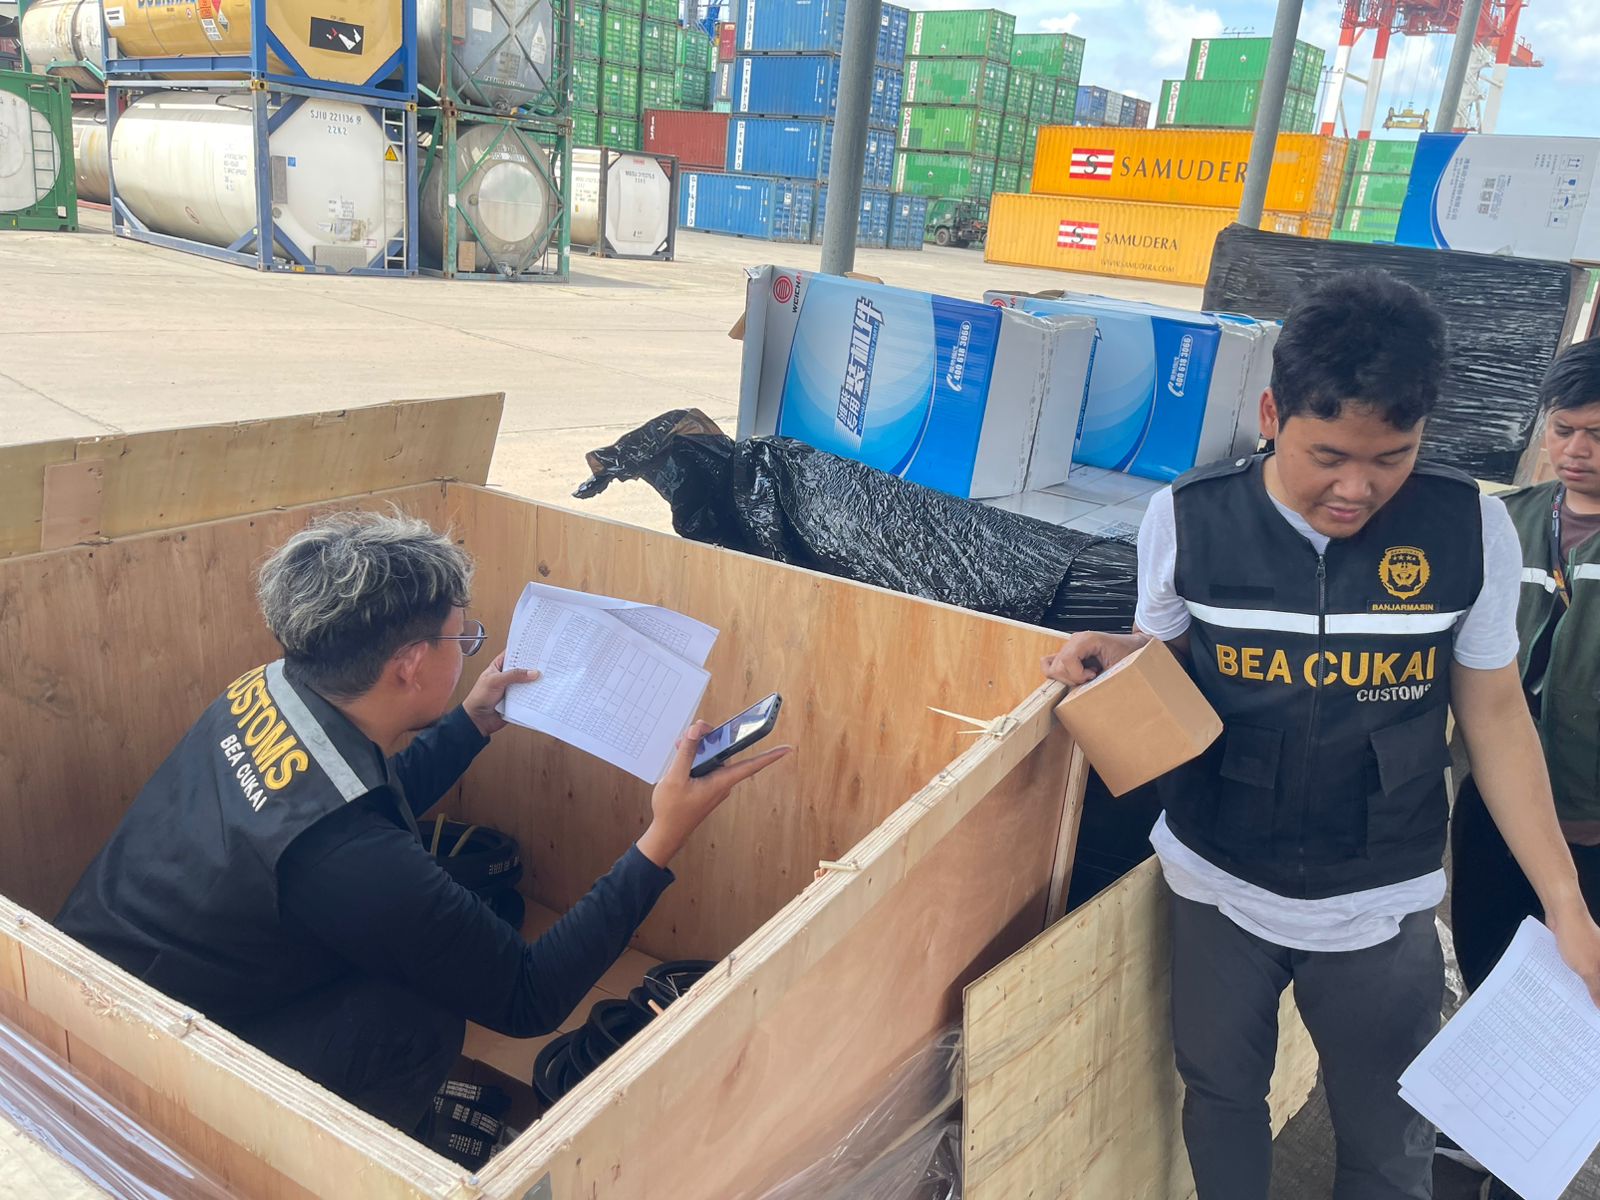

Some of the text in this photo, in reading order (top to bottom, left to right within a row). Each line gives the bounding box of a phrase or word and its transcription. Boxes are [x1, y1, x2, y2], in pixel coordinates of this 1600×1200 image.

[329, 112, 354, 124] 221136
[1120, 156, 1249, 184] SAMUDER
[1103, 231, 1178, 251] SAMUDERA
[954, 324, 970, 381] 400 618 3066
[1216, 643, 1437, 688] BEA CUKAI
[220, 734, 268, 812] BEA CUKAI
